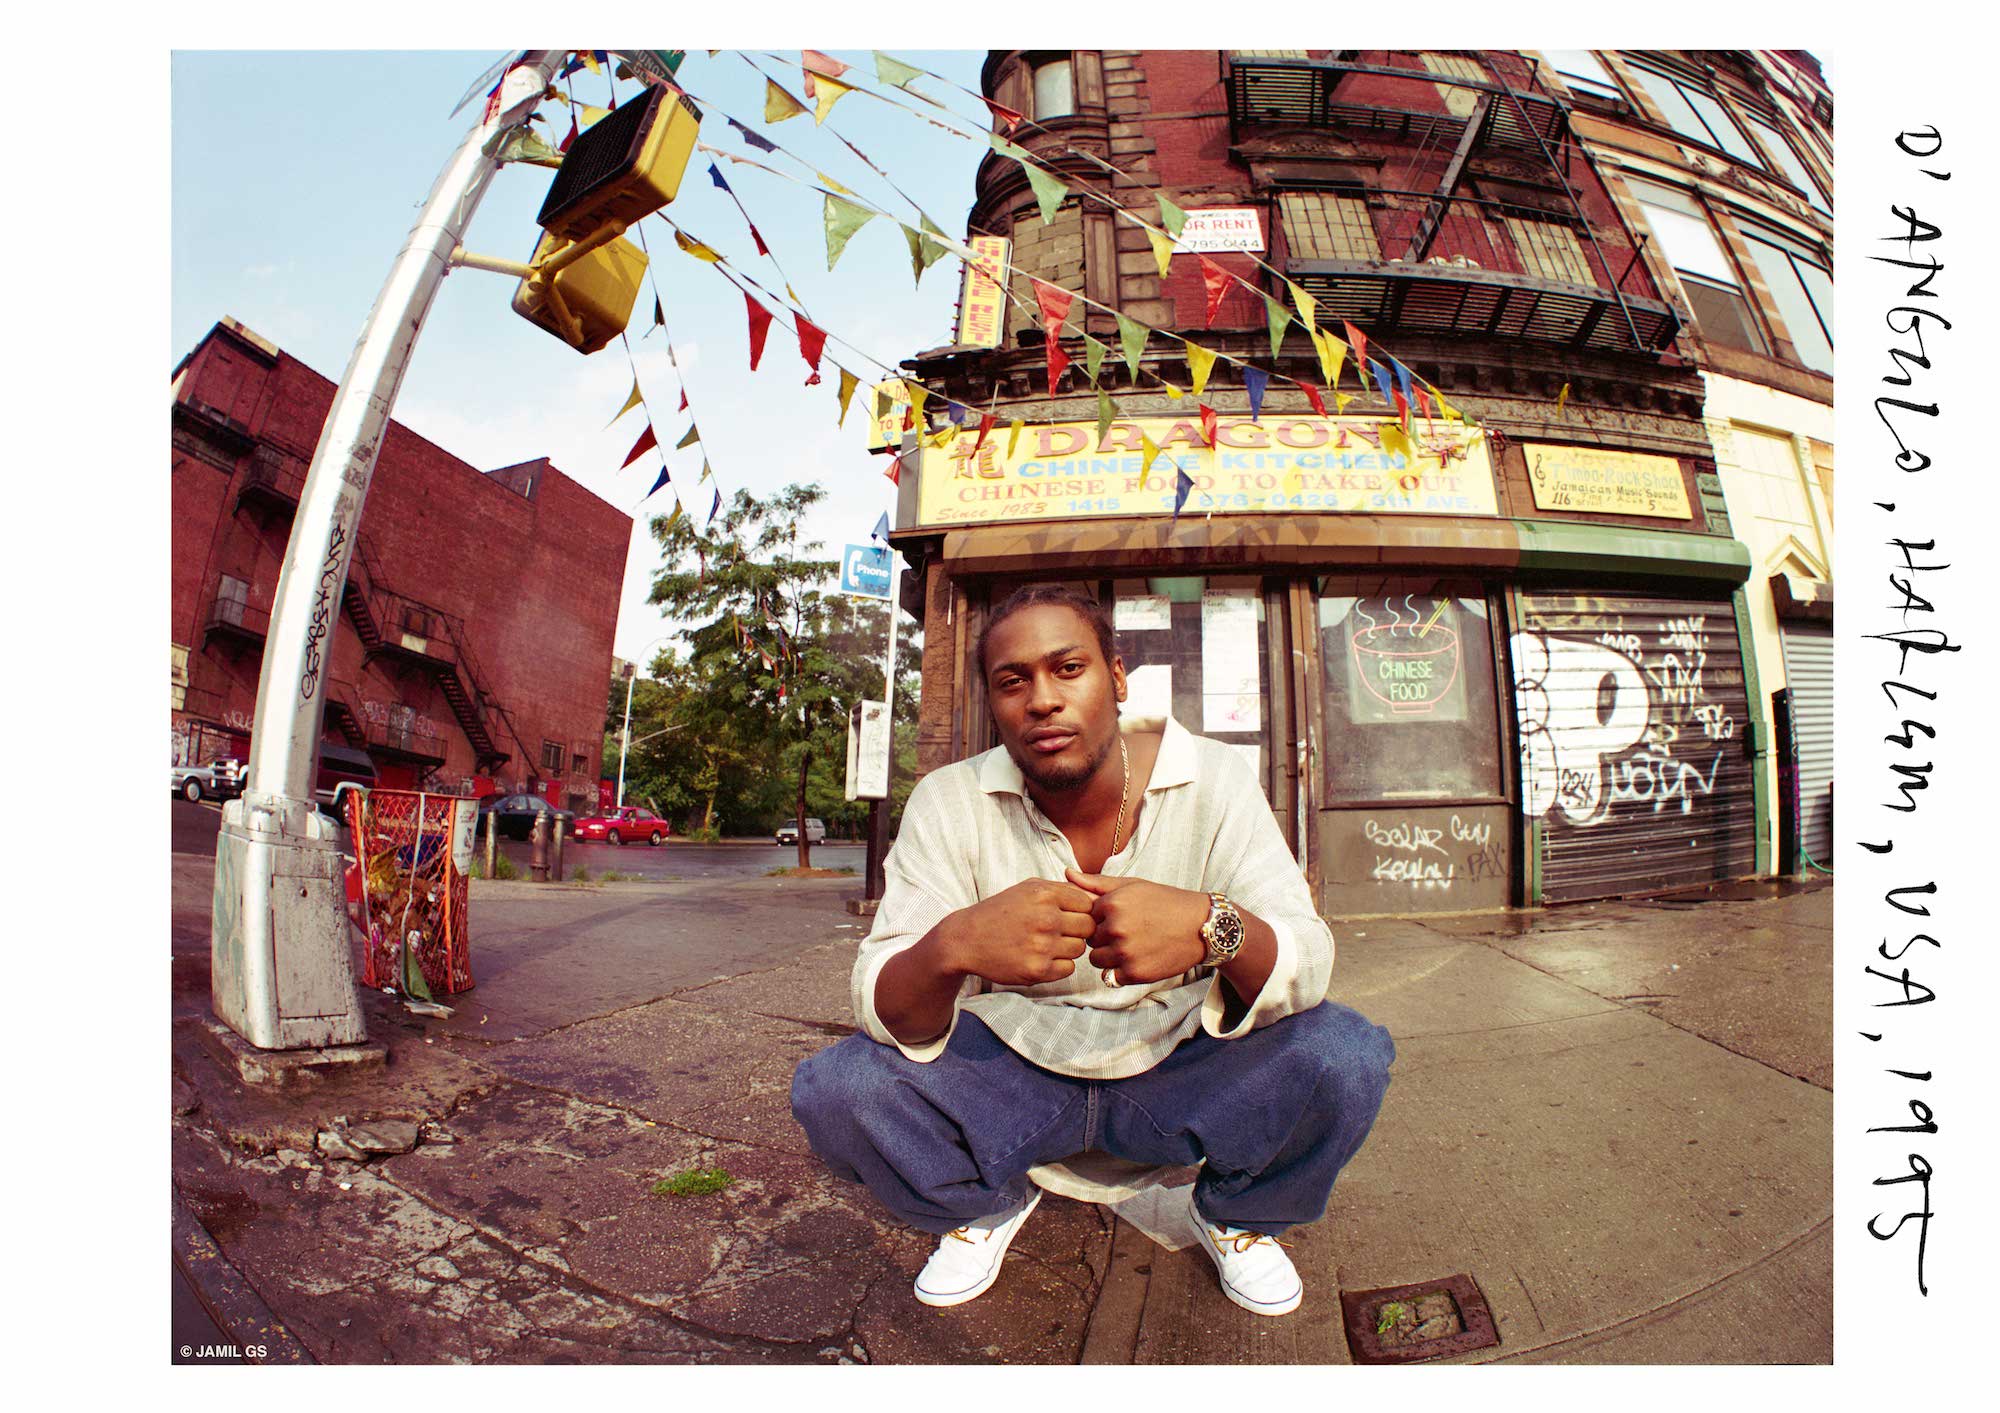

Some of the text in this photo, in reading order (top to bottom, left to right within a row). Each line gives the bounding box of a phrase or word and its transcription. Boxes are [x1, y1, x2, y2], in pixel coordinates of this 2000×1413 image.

[1184, 219, 1253, 231] OR RENT
[1034, 419, 1384, 458] DRAGON
[948, 436, 1006, 479] 龍
[1018, 453, 1407, 478] CHINESE KITCHEN
[957, 473, 1463, 503] CHINESE FOOD TO TAKE OUT
[1552, 481, 1612, 496] Jamaican
[1617, 486, 1642, 498] Music
[1552, 491, 1571, 506] 116
[936, 507, 988, 521] Since
[1000, 502, 1048, 517] 1983
[1067, 497, 1121, 513] 1415
[857, 563, 889, 578] Phone
[1379, 661, 1433, 680] CHINESE
[1390, 683, 1428, 701] FOOD
[1866, 1070, 1938, 1296] 1995
